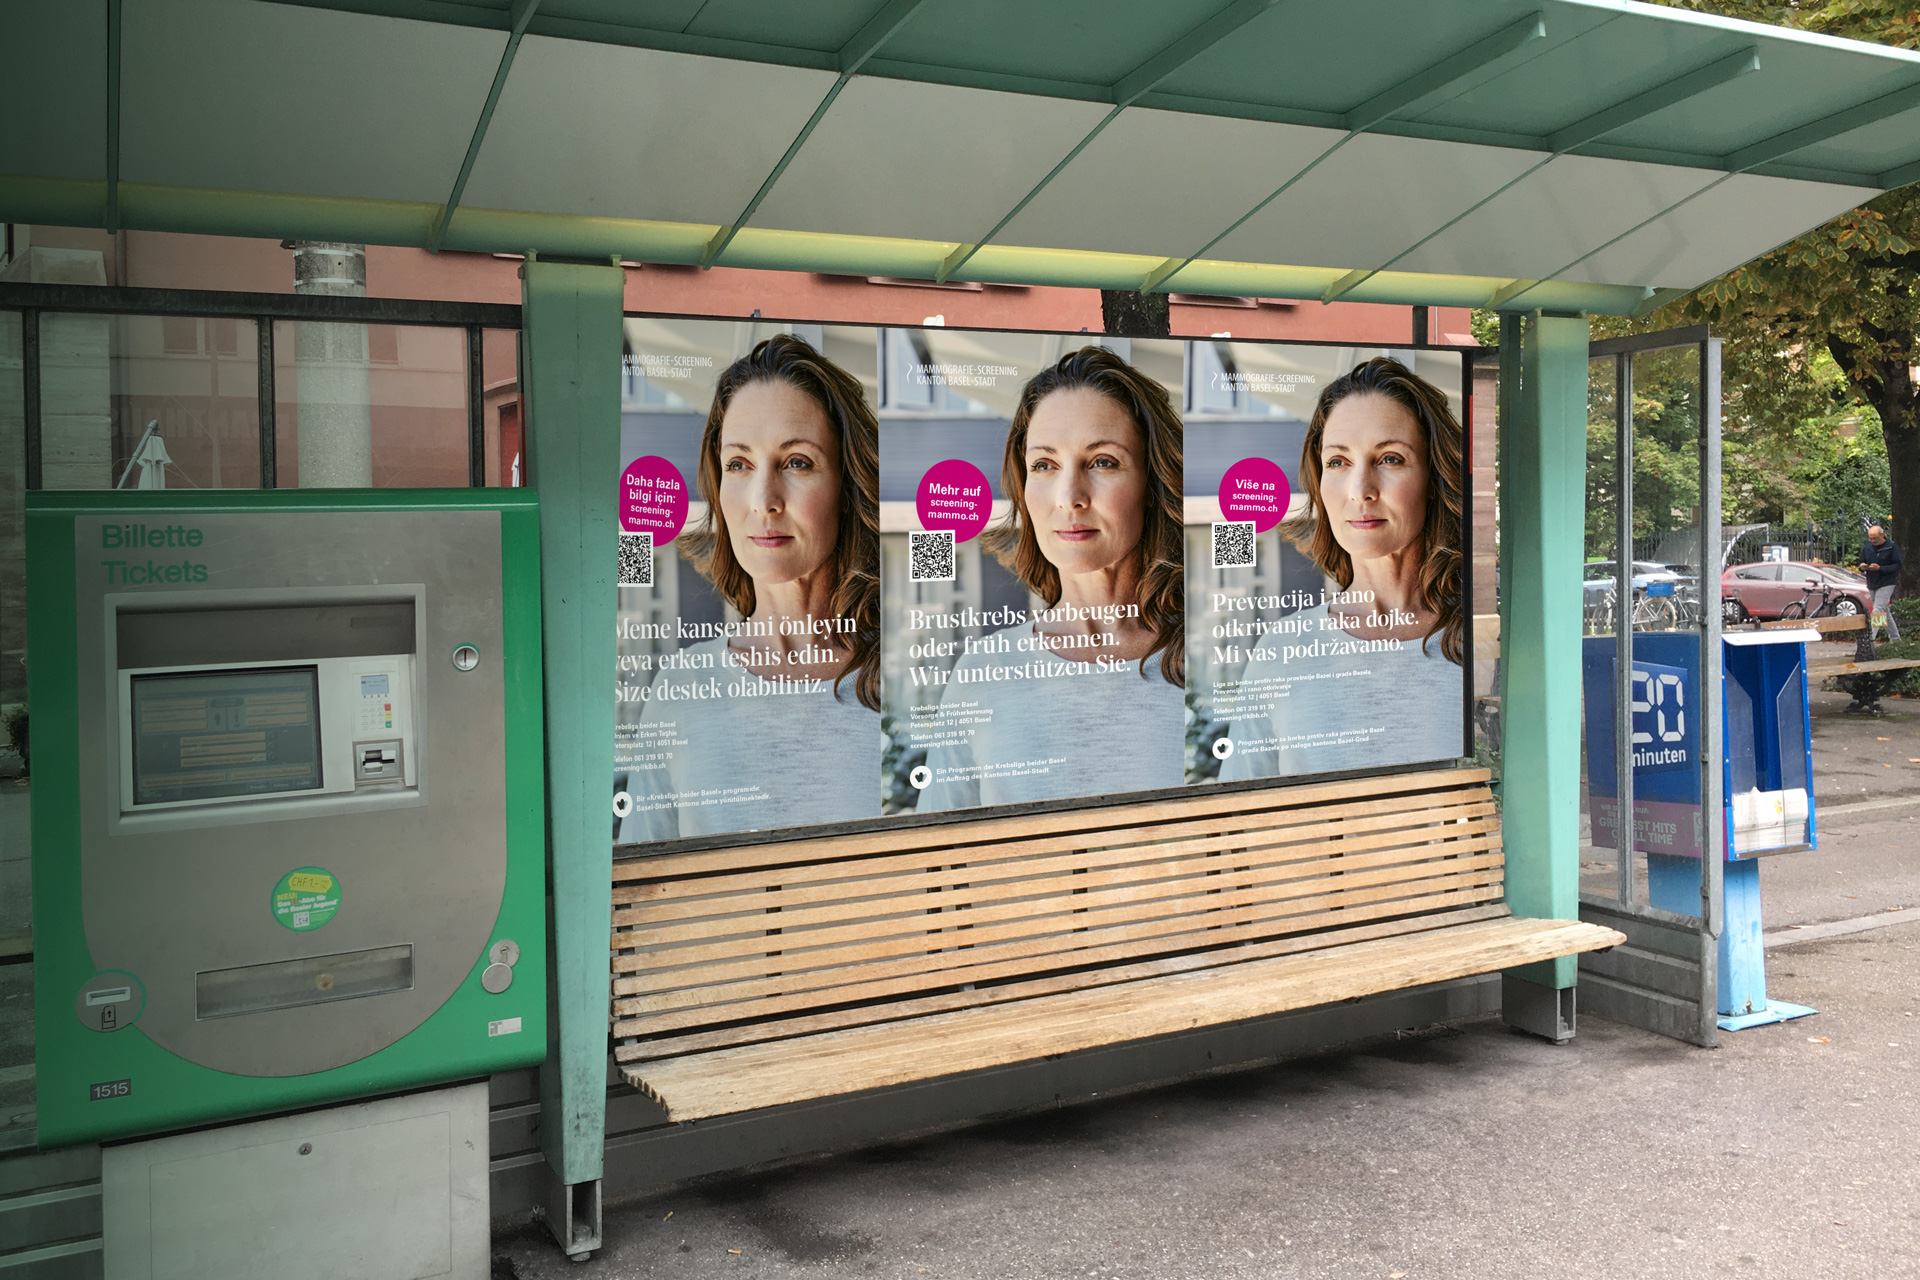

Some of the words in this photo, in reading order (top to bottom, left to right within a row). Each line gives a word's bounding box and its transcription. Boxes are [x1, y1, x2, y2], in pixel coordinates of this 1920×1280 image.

[622, 354, 712, 367] AMMOGRAFIE-SCREENING
[622, 366, 645, 376] ANTON
[646, 367, 692, 378] BASEL-STADT
[916, 364, 1018, 376] MAMMOGRAFIE-SCREENING
[916, 375, 946, 386] KANTON
[948, 376, 996, 386] BASEL-STADT
[1220, 372, 1316, 384] MAMMOGRAFIE-SCREENING
[1220, 382, 1250, 392] KANTON
[1250, 384, 1296, 392] BASEL-STADT
[626, 474, 653, 487] Daha
[656, 477, 680, 490] fazla
[1236, 478, 1260, 490] Više
[929, 482, 960, 496] Mehr
[962, 486, 982, 496] auf
[629, 488, 652, 504] bilgi
[654, 491, 676, 506] için:
[1232, 492, 1277, 502] screening-
[930, 498, 978, 510] screening-
[1230, 504, 1278, 512] mammo.ch
[630, 504, 673, 518] screening-
[928, 511, 979, 521] mammo.ch
[628, 516, 674, 528] mammo.ch
[102, 524, 204, 549] Billette
[100, 560, 208, 585] Tickets
[1212, 589, 1314, 612] Prevencija
[1320, 588, 1327, 606] i
[1331, 590, 1375, 604] rano
[909, 606, 1027, 630] Brustkrebs
[1031, 602, 1139, 624] vorbeugen
[676, 616, 774, 639] kanserini
[779, 614, 858, 640] önleyin
[1212, 616, 1313, 638] otkrivanje
[1318, 610, 1360, 631] raka
[1366, 608, 1419, 630] dojke.
[909, 638, 958, 659] oder
[964, 636, 1010, 655] früh
[1016, 632, 1120, 652] erkennen.
[1212, 644, 1240, 664] Mi
[1246, 646, 1277, 662] vas
[1282, 638, 1404, 664] podržavamo.
[658, 648, 714, 670] erken
[720, 646, 782, 673] teşhis
[787, 644, 840, 665] edin.
[908, 666, 950, 686] Wir
[956, 660, 1090, 684] unterstützen
[1094, 654, 1131, 674] Sie.
[1286, 674, 1315, 682] provincije
[656, 677, 722, 700] destek
[728, 674, 826, 698] olabiliriz.
[910, 704, 938, 712] Krebsliga
[940, 702, 960, 710] beider
[946, 708, 993, 717] Früherkennung
[615, 723, 638, 731] rebsliga
[660, 720, 676, 728] Basel
[910, 721, 945, 729] Petersplatz
[614, 742, 644, 750] etersplatz
[672, 738, 688, 746] Basel
[1242, 747, 1258, 755] grada
[1338, 736, 1369, 745] Bazel-Grad
[996, 760, 1025, 769] Krebsliga
[1012, 768, 1049, 776] Basel-Stadt
[636, 802, 672, 811] Basel-Stadt
[1652, 821, 1677, 834] HITS
[1648, 832, 1673, 845] TIME
[292, 877, 307, 887] CHF
[94, 1082, 128, 1098] 1515
